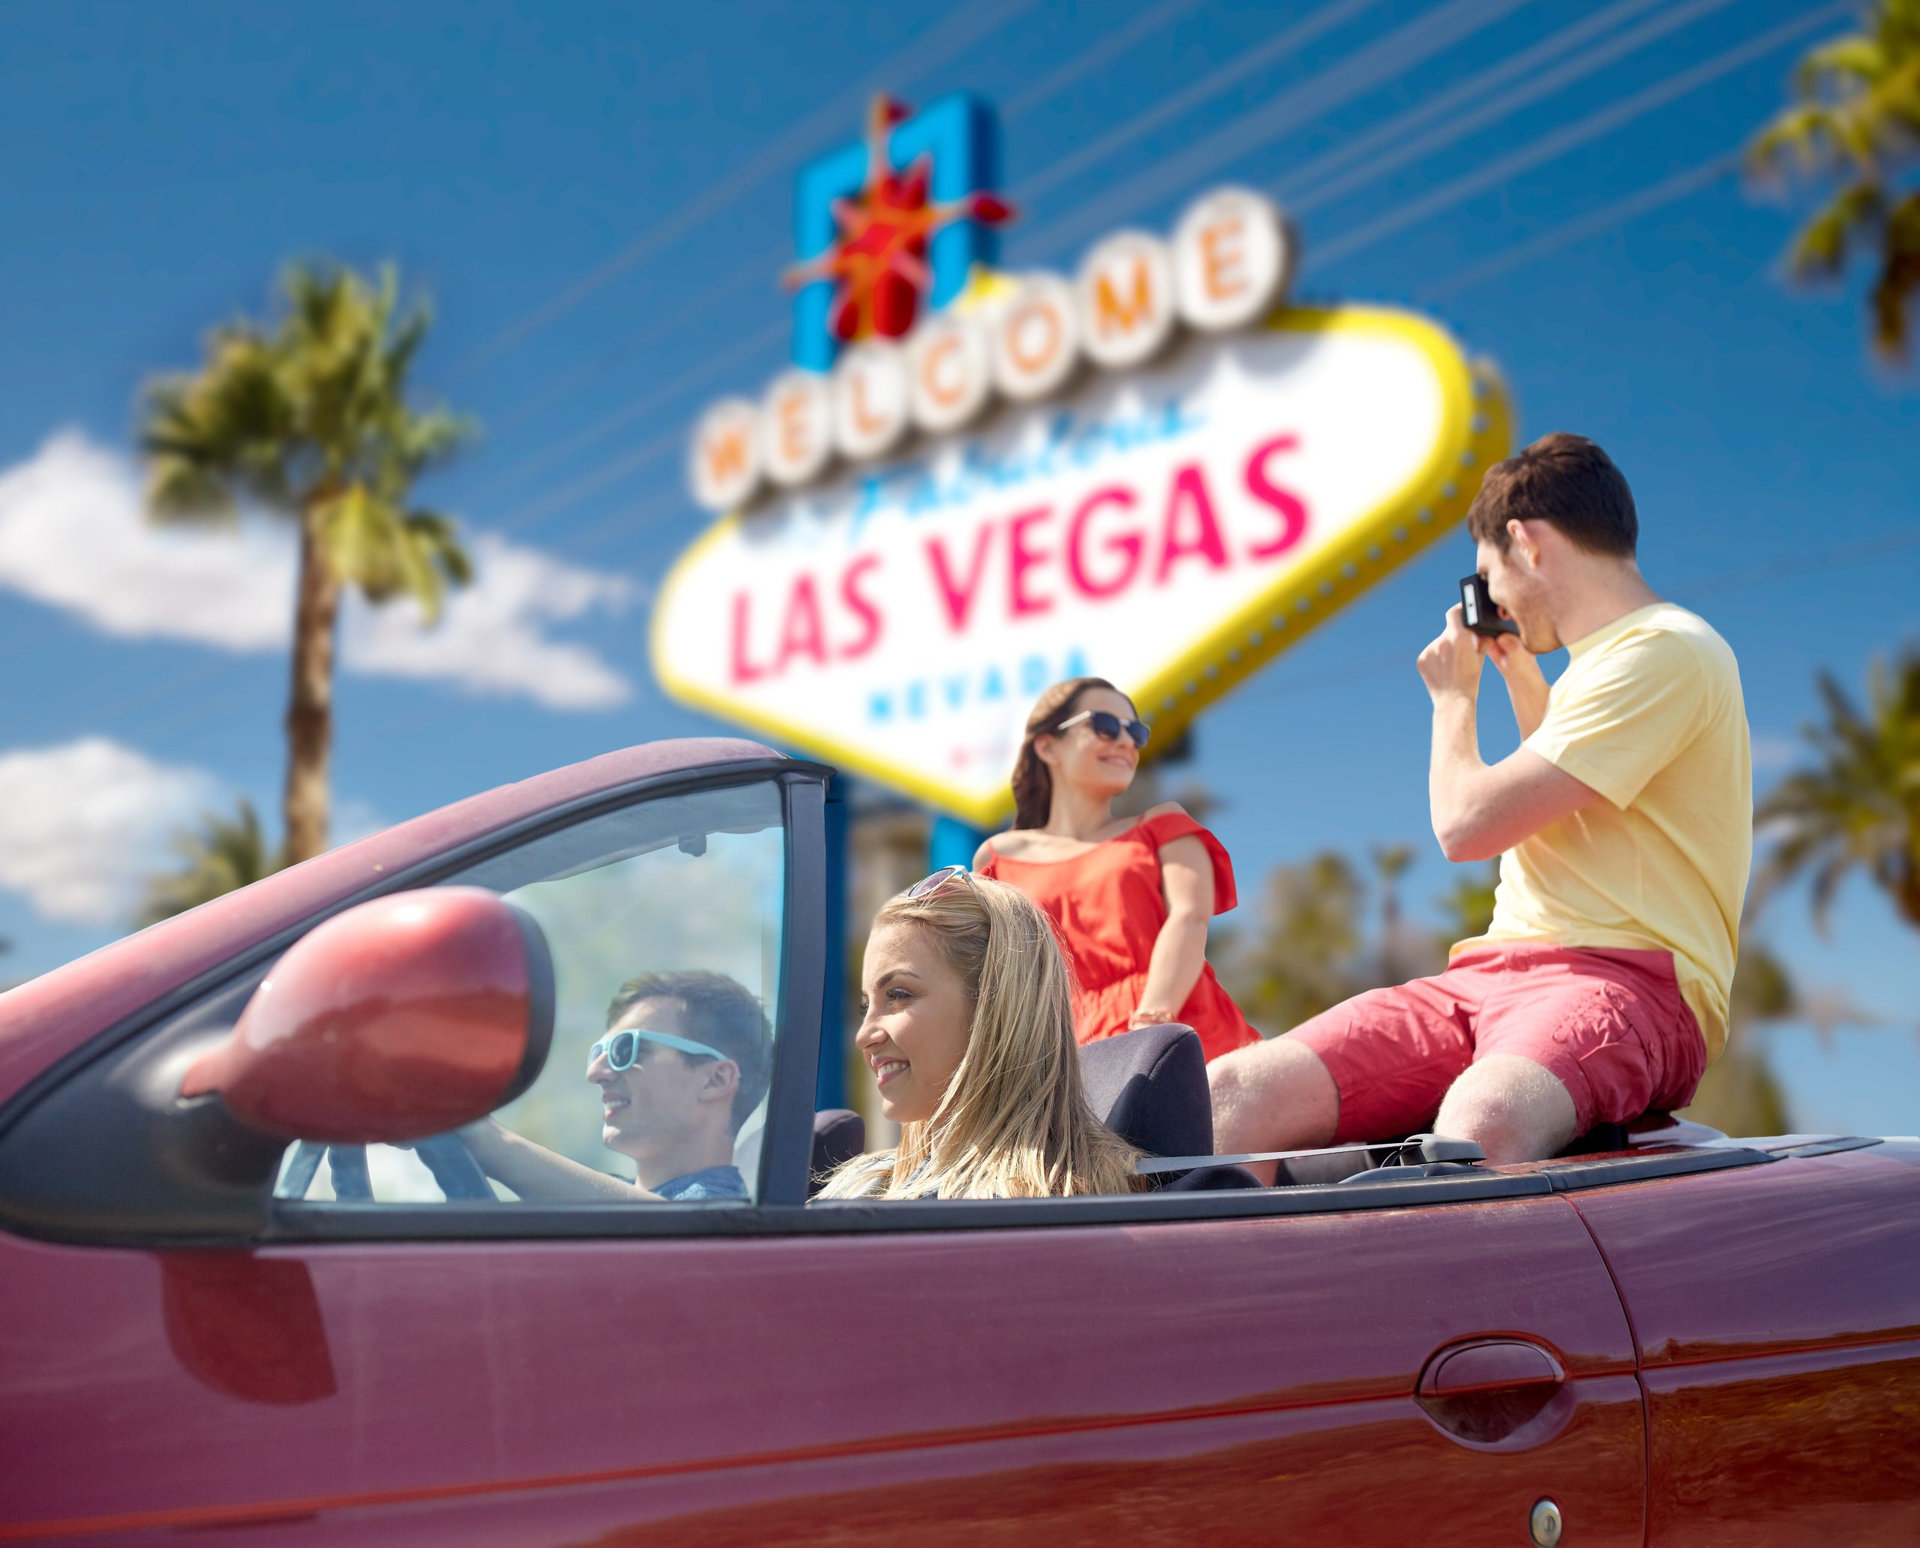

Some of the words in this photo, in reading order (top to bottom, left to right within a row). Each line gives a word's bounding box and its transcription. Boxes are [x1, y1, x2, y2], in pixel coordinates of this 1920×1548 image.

[705, 211, 1250, 487] WELCOME
[727, 557, 886, 686] LAS
[924, 432, 1315, 638] VEGAS
[866, 645, 1091, 723] NEVADA
